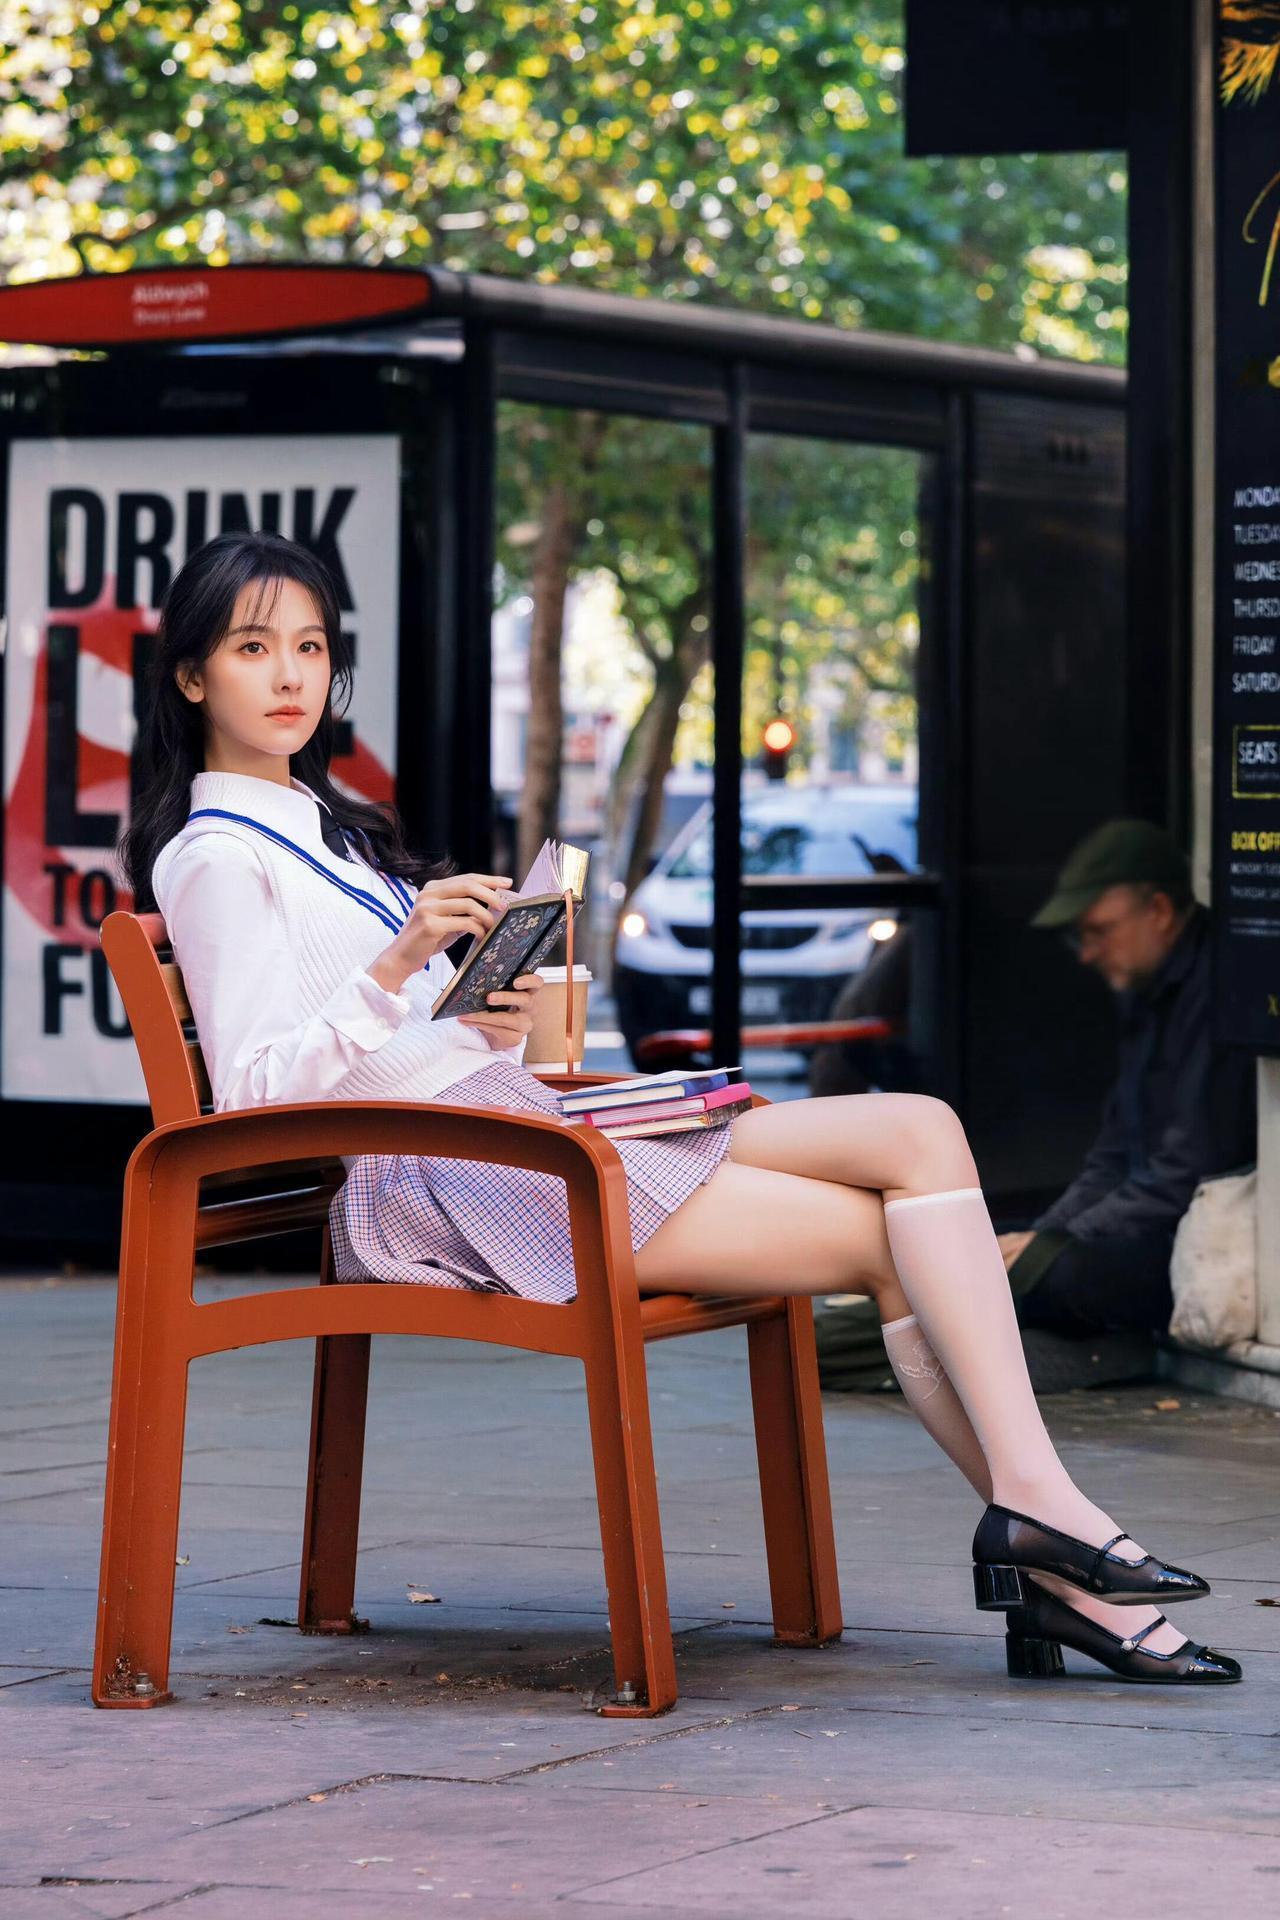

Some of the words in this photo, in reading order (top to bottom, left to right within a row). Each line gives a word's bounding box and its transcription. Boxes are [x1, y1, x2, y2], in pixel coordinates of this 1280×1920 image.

[1233, 635, 1276, 656] FRIDAY
[1232, 671, 1280, 692] SATURD
[1239, 741, 1278, 765] SEATS
[1231, 831, 1257, 850] BOX
[43, 864, 117, 930] TO
